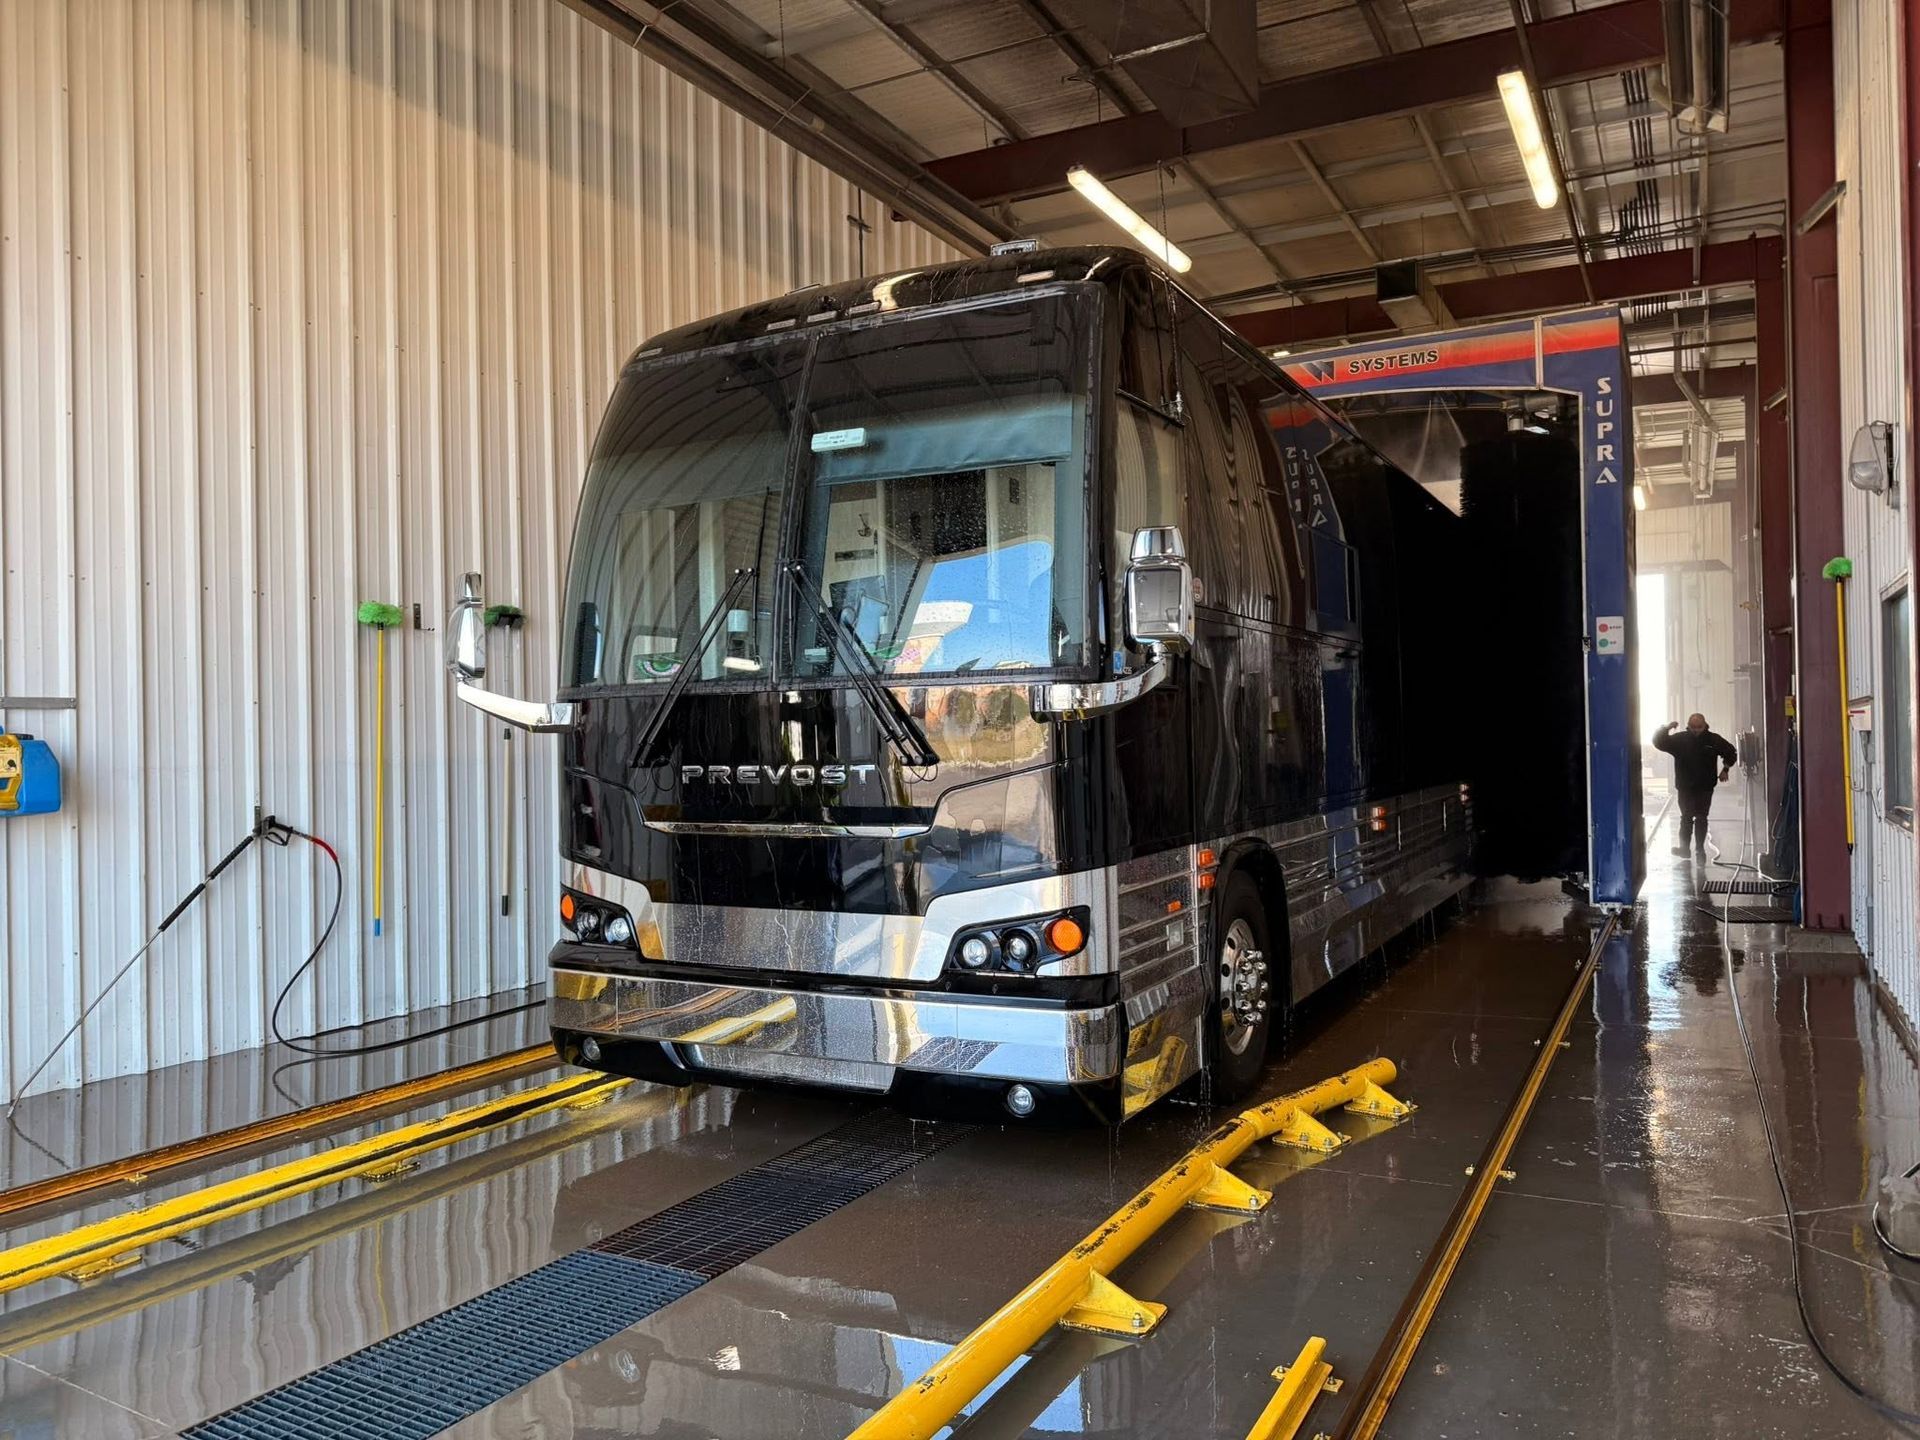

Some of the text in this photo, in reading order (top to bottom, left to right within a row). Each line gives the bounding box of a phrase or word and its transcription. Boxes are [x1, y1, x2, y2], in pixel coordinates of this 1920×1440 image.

[1349, 349, 1438, 374] SYSTEMS
[1595, 376, 1618, 484] SUPRA
[682, 765, 875, 786] PREVOST
